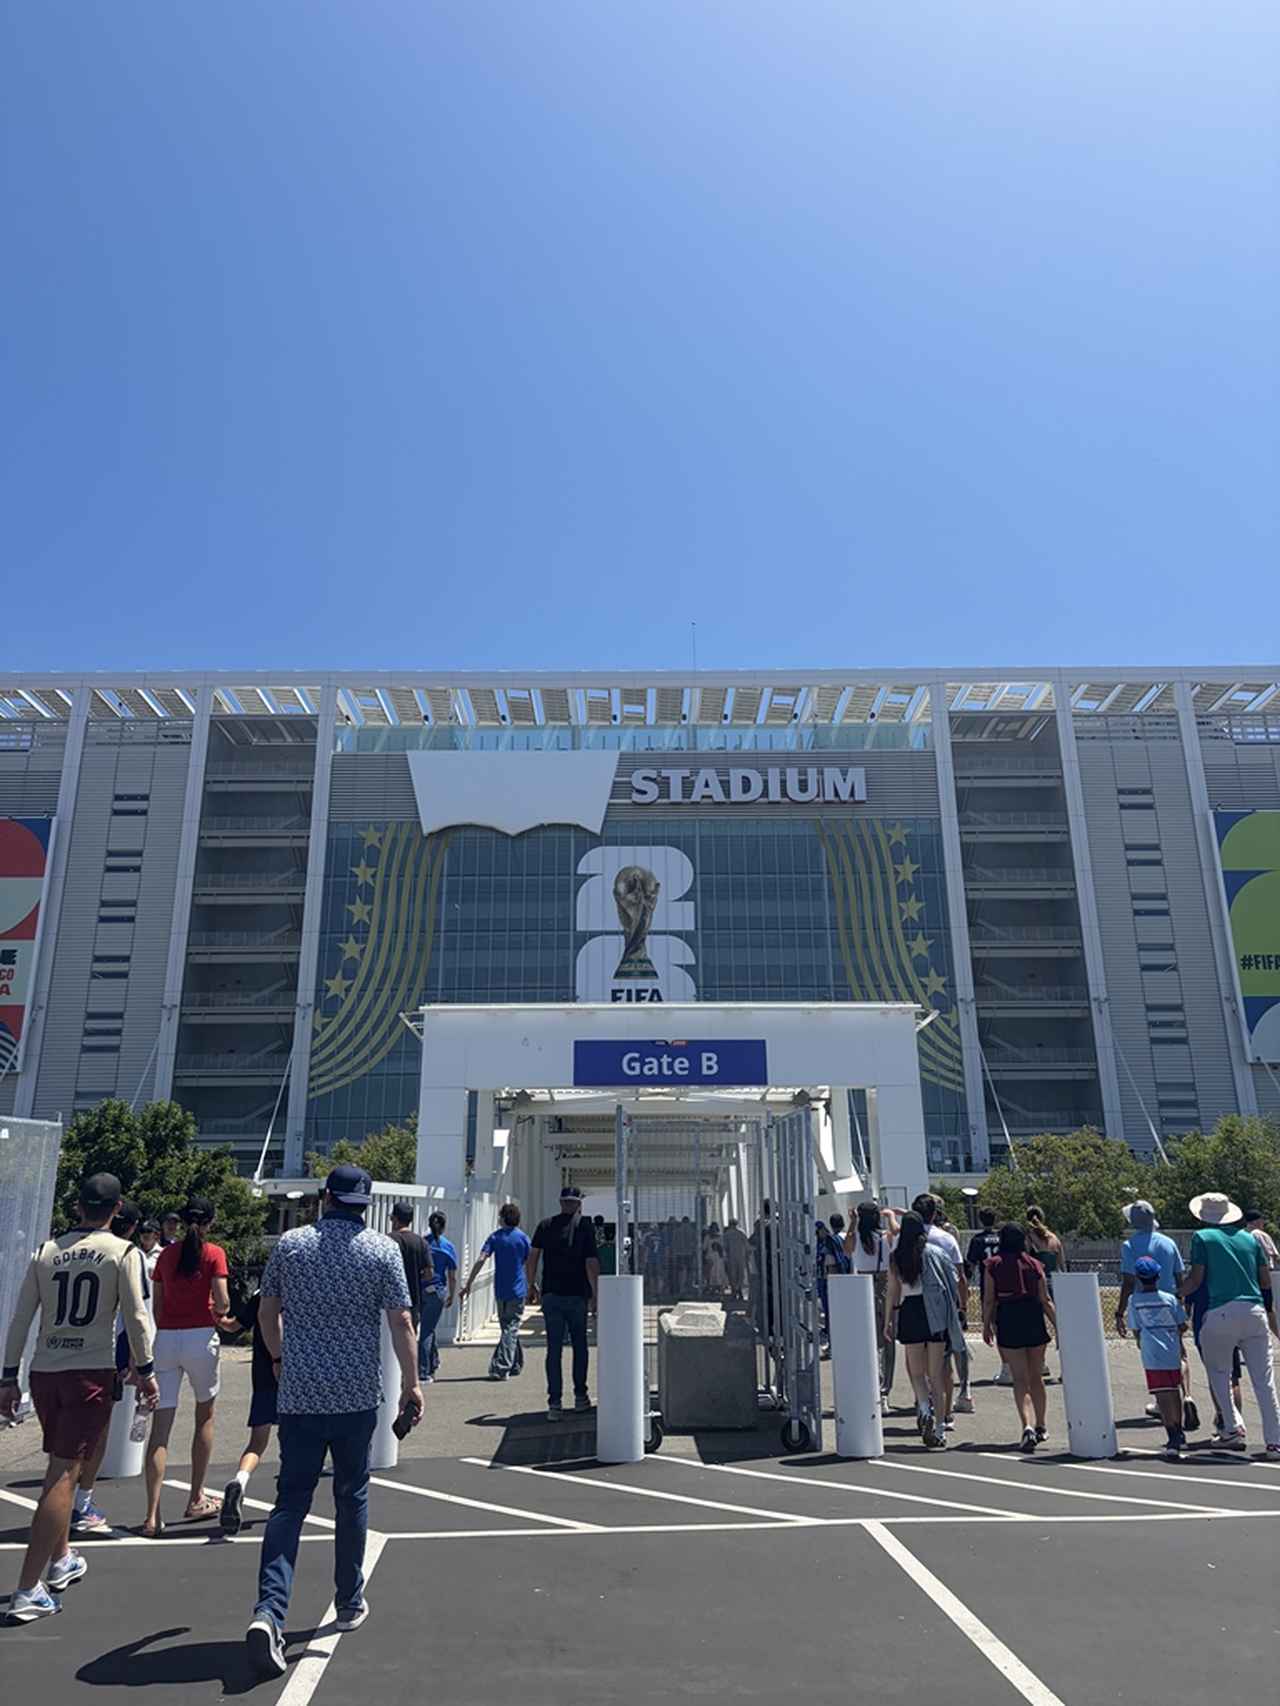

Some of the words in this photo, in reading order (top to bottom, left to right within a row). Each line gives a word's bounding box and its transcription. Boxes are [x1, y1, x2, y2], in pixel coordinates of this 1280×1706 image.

[631, 767, 868, 804] STADIUM
[611, 989, 664, 1003] FIFA
[622, 1052, 690, 1076] Gate
[701, 1053, 719, 1075] B
[52, 1271, 99, 1327] 10
